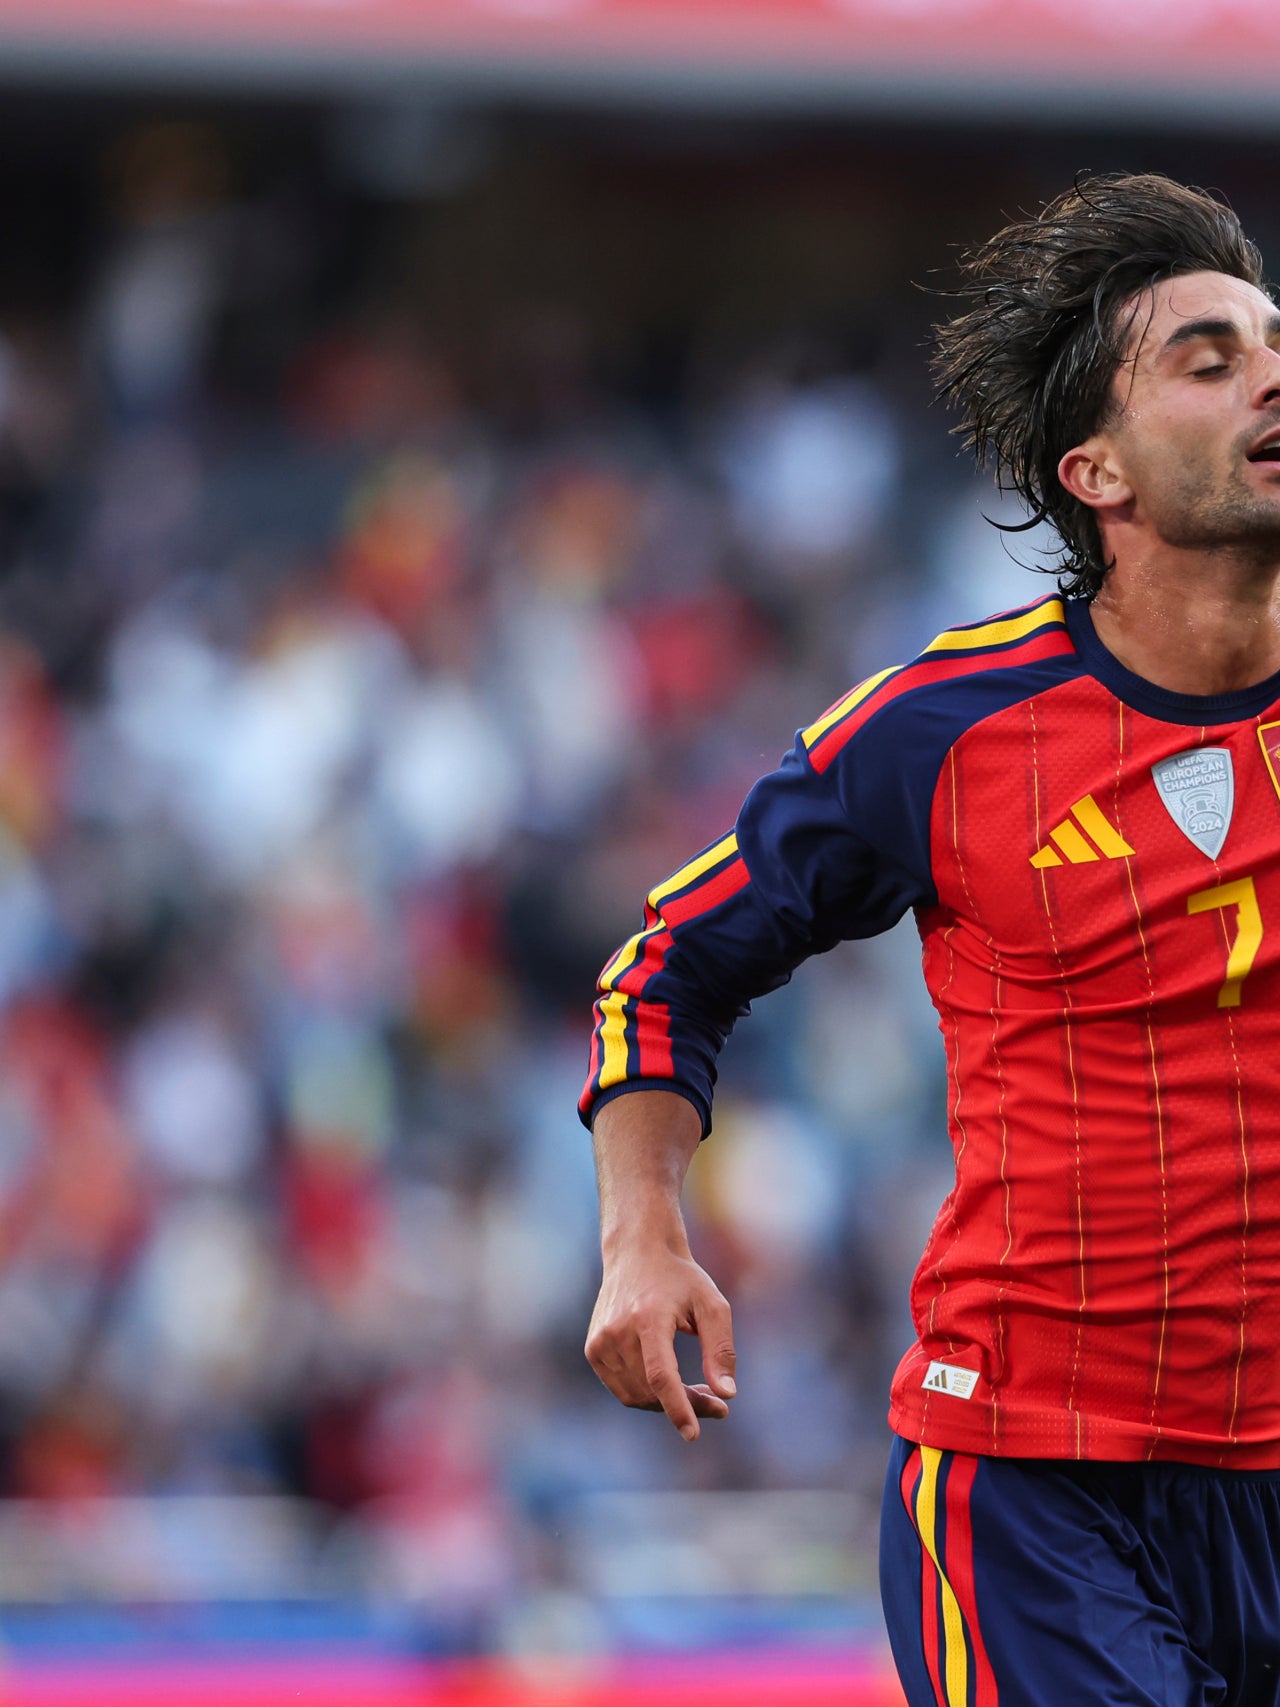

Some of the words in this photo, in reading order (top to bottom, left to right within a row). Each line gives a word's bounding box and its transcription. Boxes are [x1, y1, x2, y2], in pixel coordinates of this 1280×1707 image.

[1160, 760, 1224, 782] EUROPEAN
[1177, 755, 1203, 767] UEFA
[1164, 771, 1227, 792] CHAMPIONS
[1191, 818, 1222, 834] 2024
[1187, 876, 1264, 1008] 7
